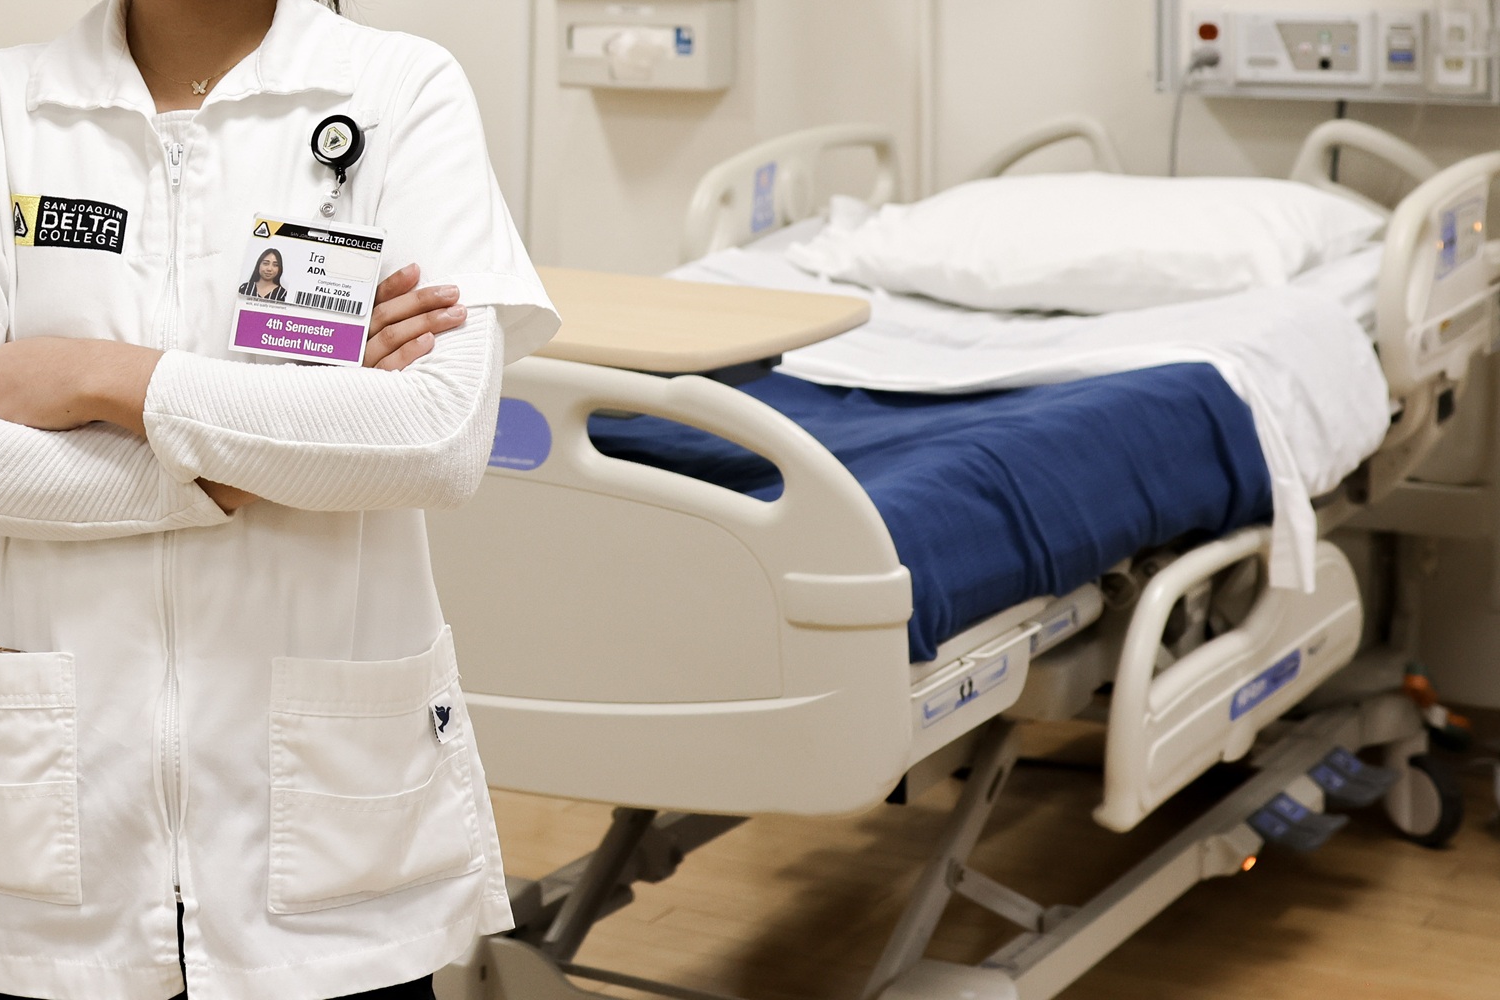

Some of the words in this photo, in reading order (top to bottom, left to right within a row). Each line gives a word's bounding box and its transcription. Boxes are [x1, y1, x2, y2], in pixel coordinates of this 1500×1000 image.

[43, 201, 67, 211] SAN
[71, 204, 123, 220] JOAQUIN
[41, 210, 120, 237] DELTA
[39, 229, 118, 248] COLLEGE
[345, 238, 382, 251] COLLEGE
[308, 252, 325, 264] Ira
[314, 285, 331, 294] FALL
[333, 289, 351, 297] 2026
[317, 279, 341, 288] Completion
[265, 319, 283, 331] 4th
[285, 320, 334, 337] Semester
[261, 334, 302, 350] Student
[303, 339, 334, 354] Nurse
